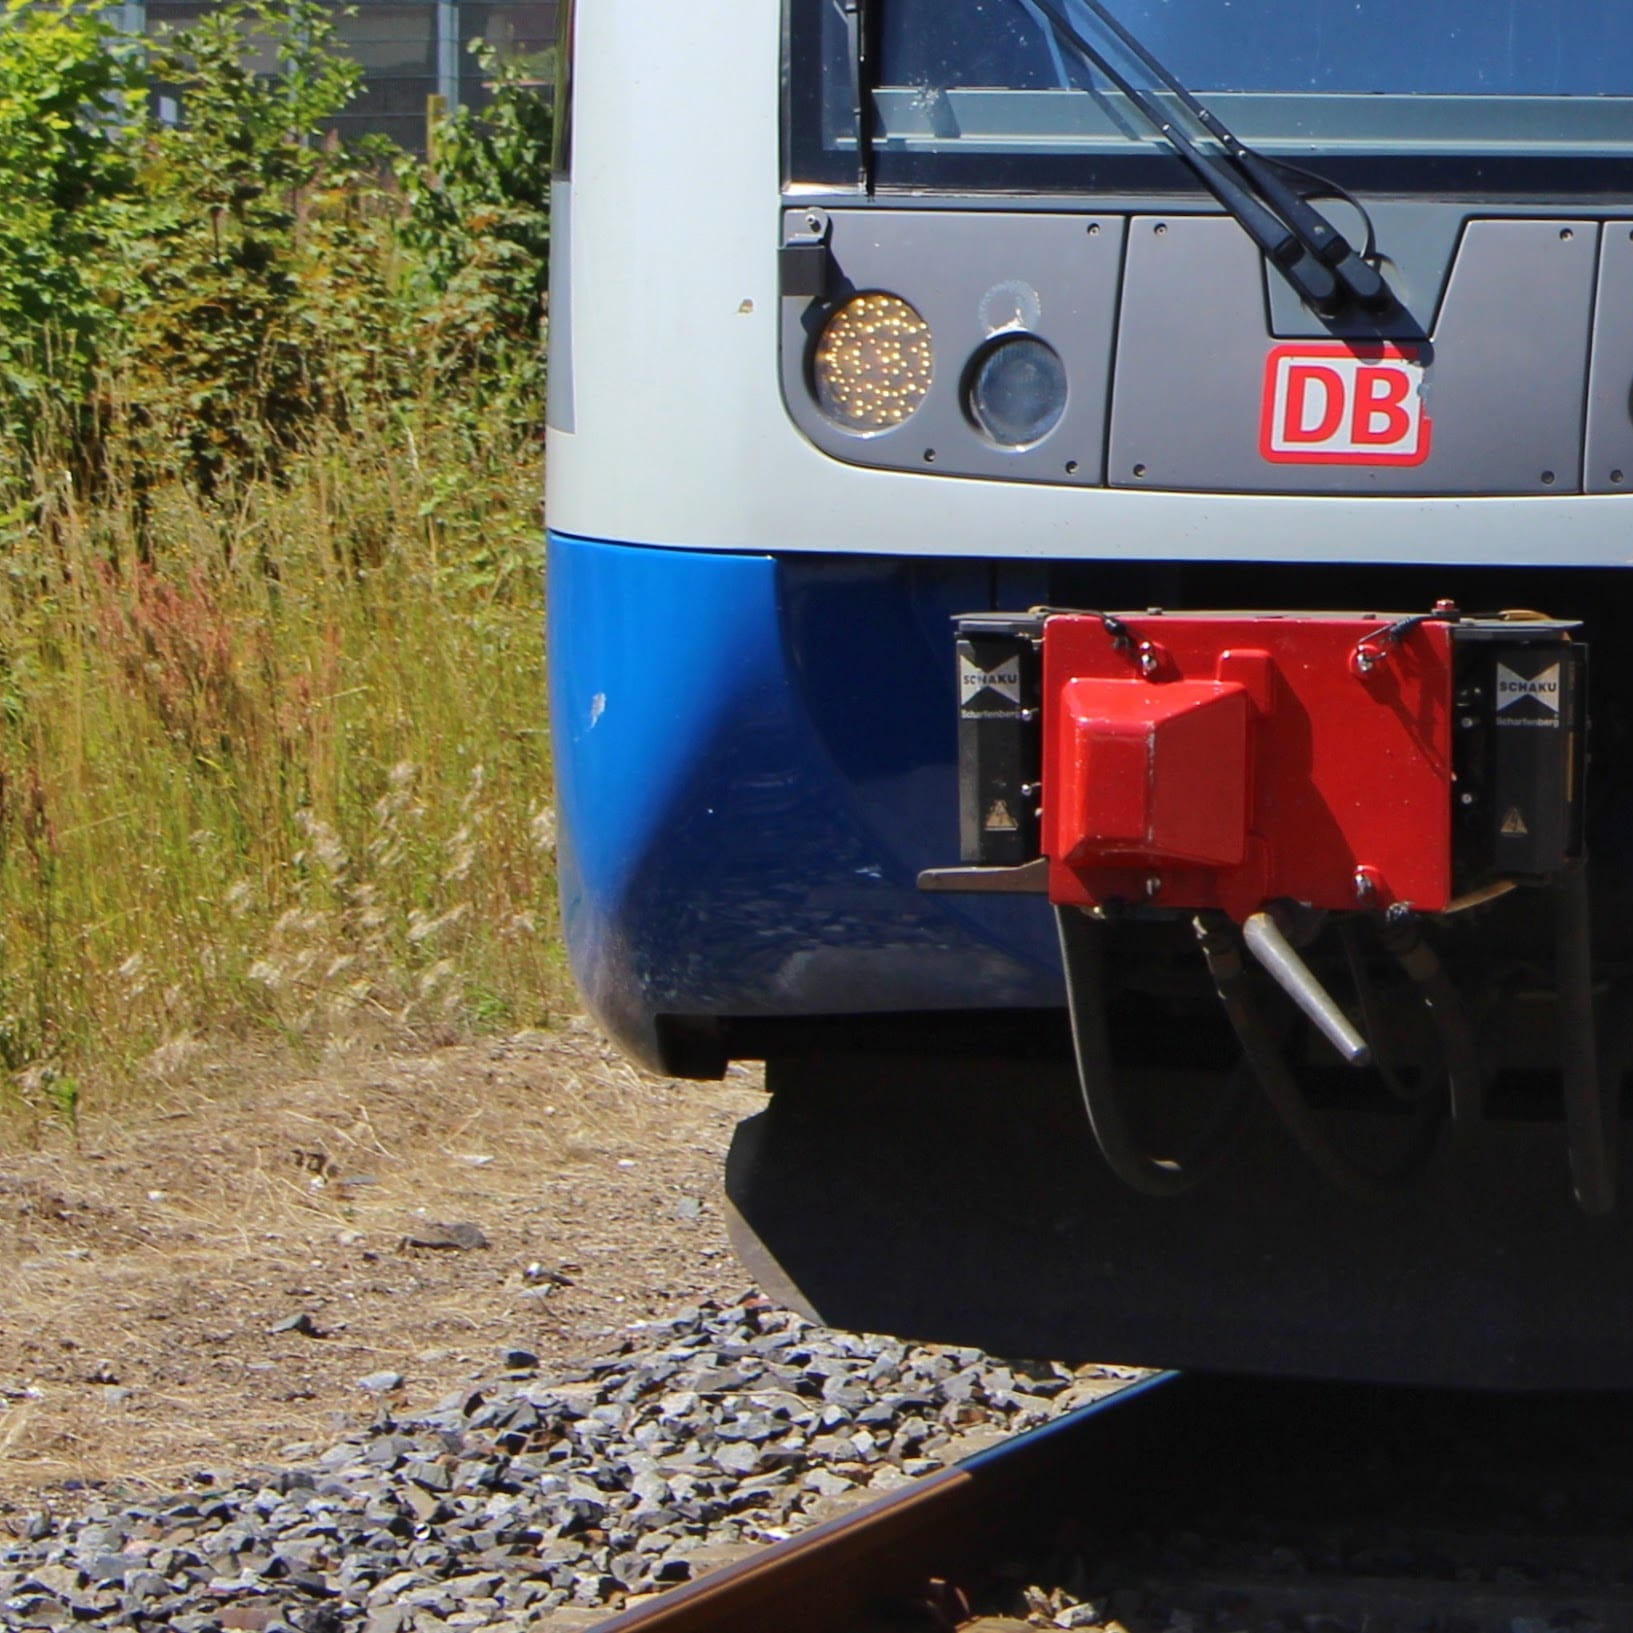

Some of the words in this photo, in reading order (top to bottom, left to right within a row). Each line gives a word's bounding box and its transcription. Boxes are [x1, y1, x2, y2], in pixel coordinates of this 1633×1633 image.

[1283, 364, 1411, 445] DB
[963, 674, 1017, 685] SCHAKU
[1499, 681, 1557, 692] SCHAKU
